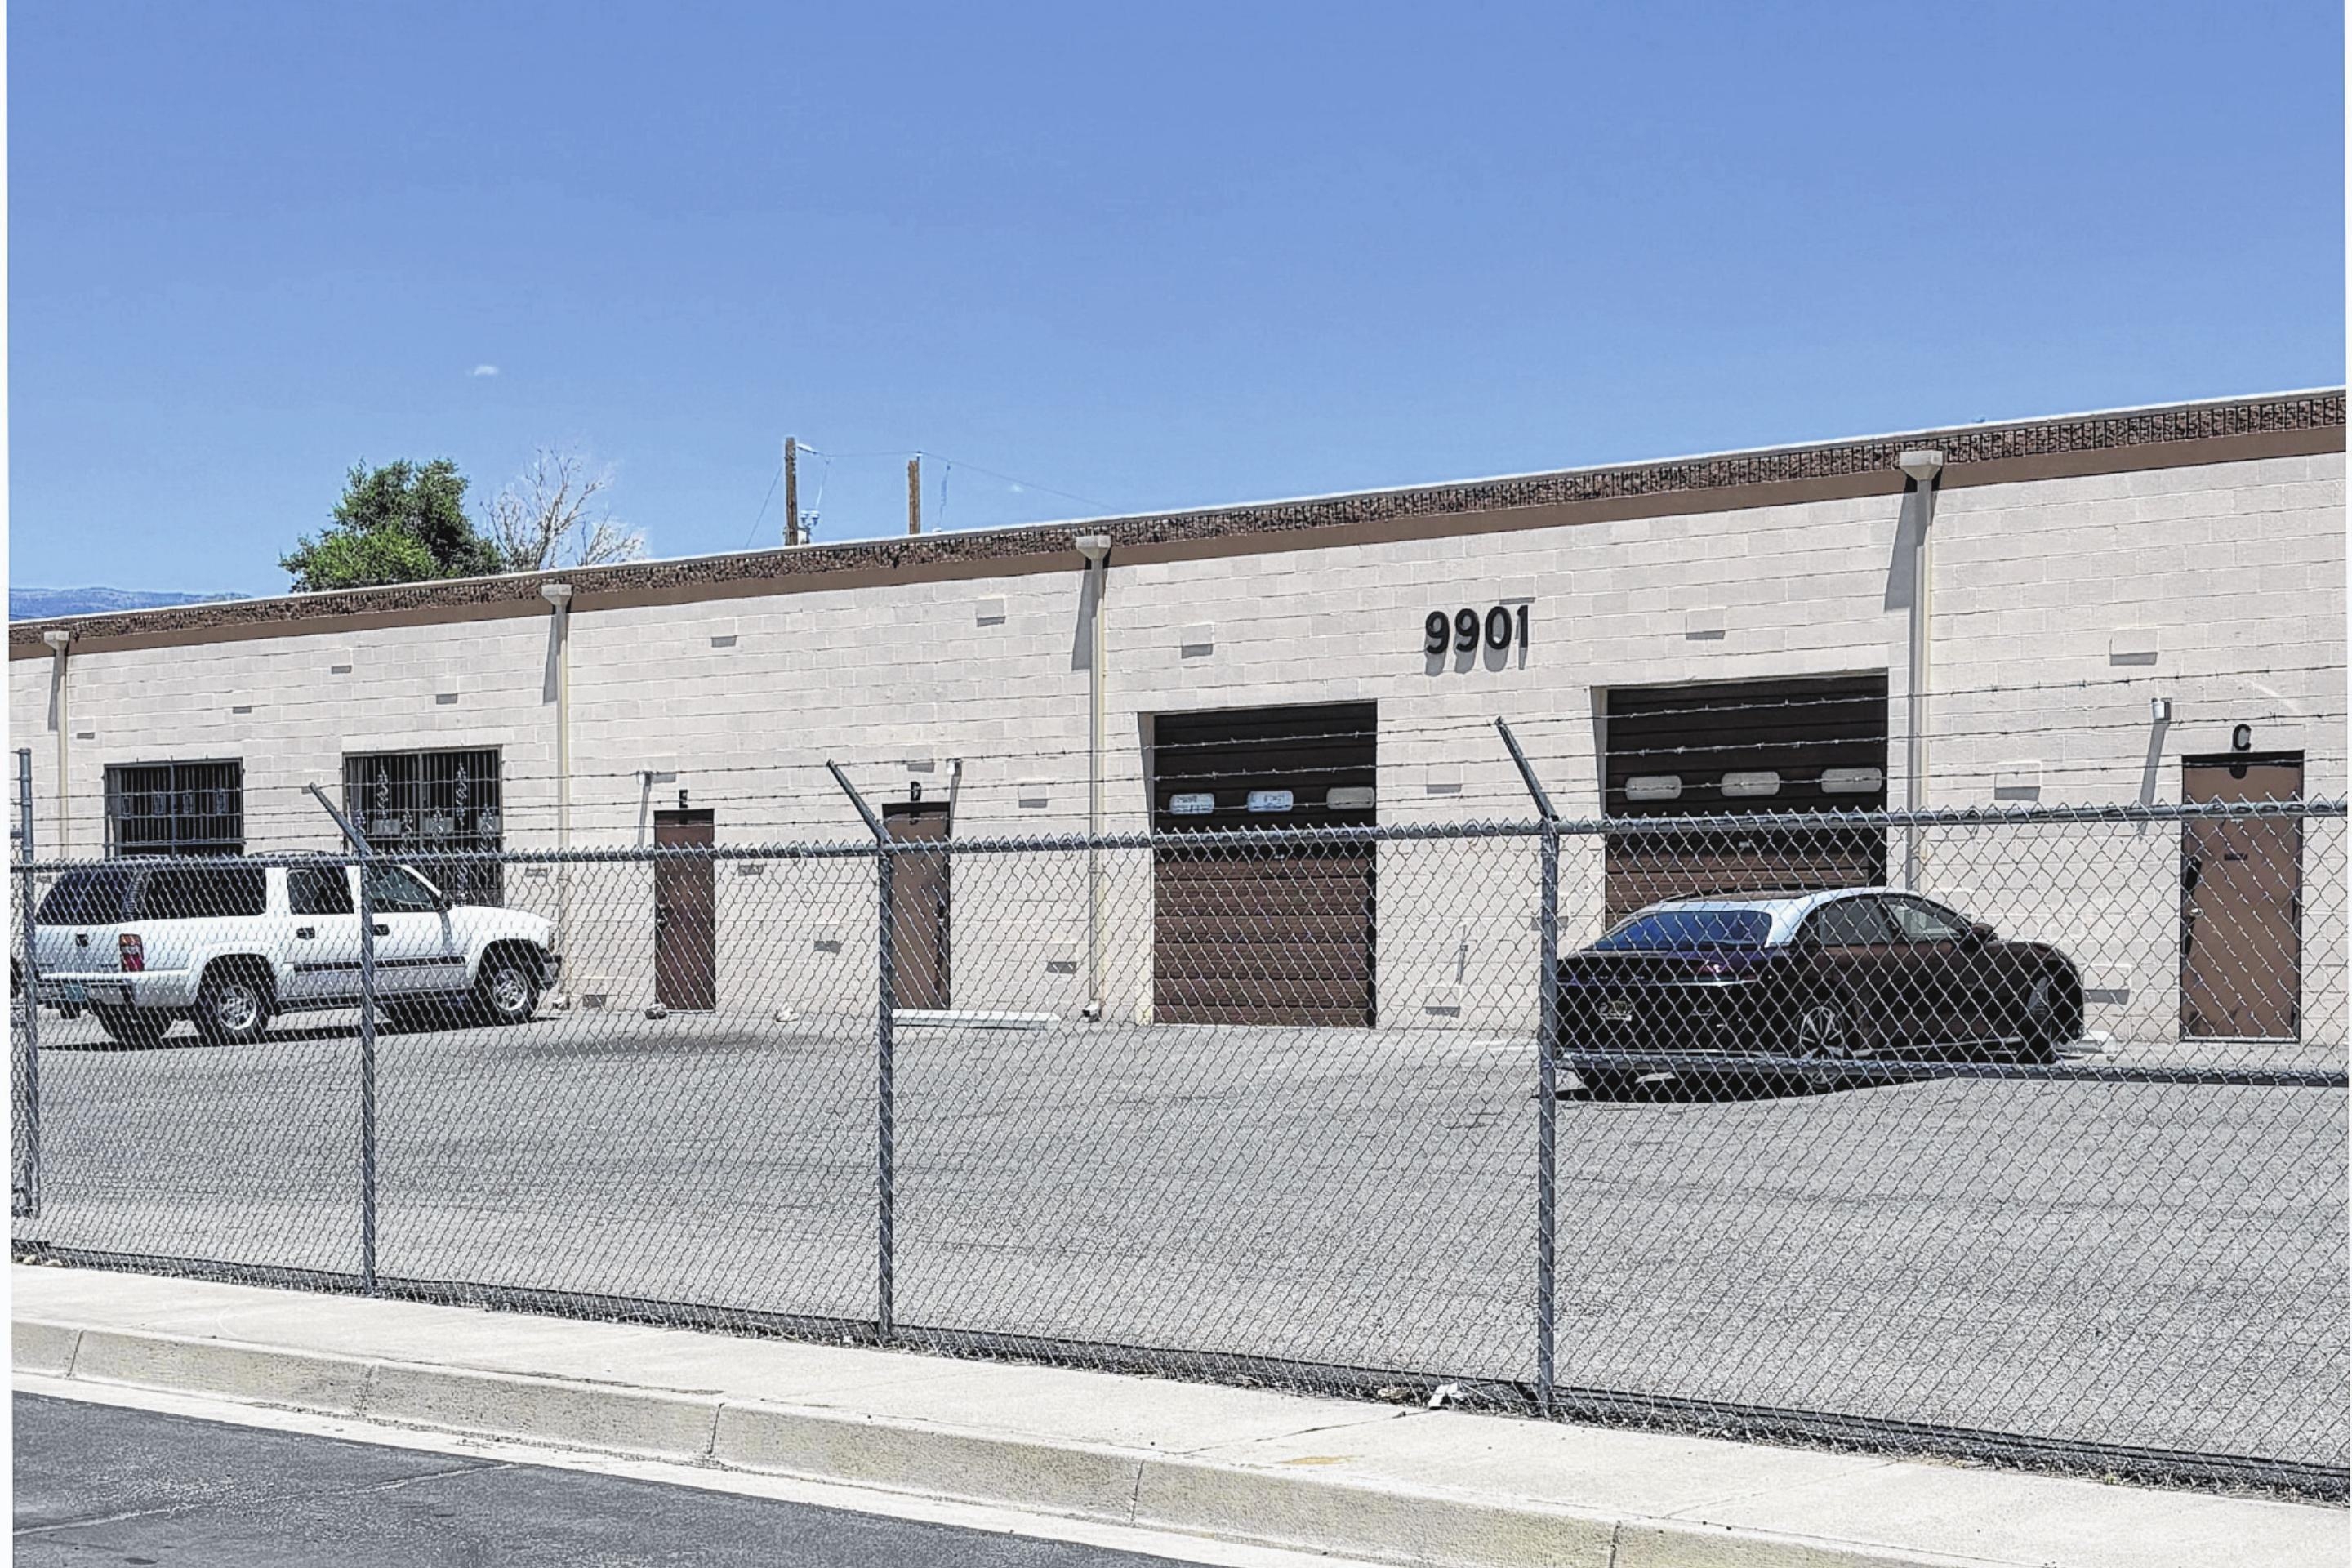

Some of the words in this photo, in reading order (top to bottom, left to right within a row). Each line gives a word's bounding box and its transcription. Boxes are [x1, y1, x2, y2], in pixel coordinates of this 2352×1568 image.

[1425, 604, 1529, 654] 9901
[2233, 724, 2252, 751] C
[679, 789, 688, 808] E
[910, 781, 921, 801] D
